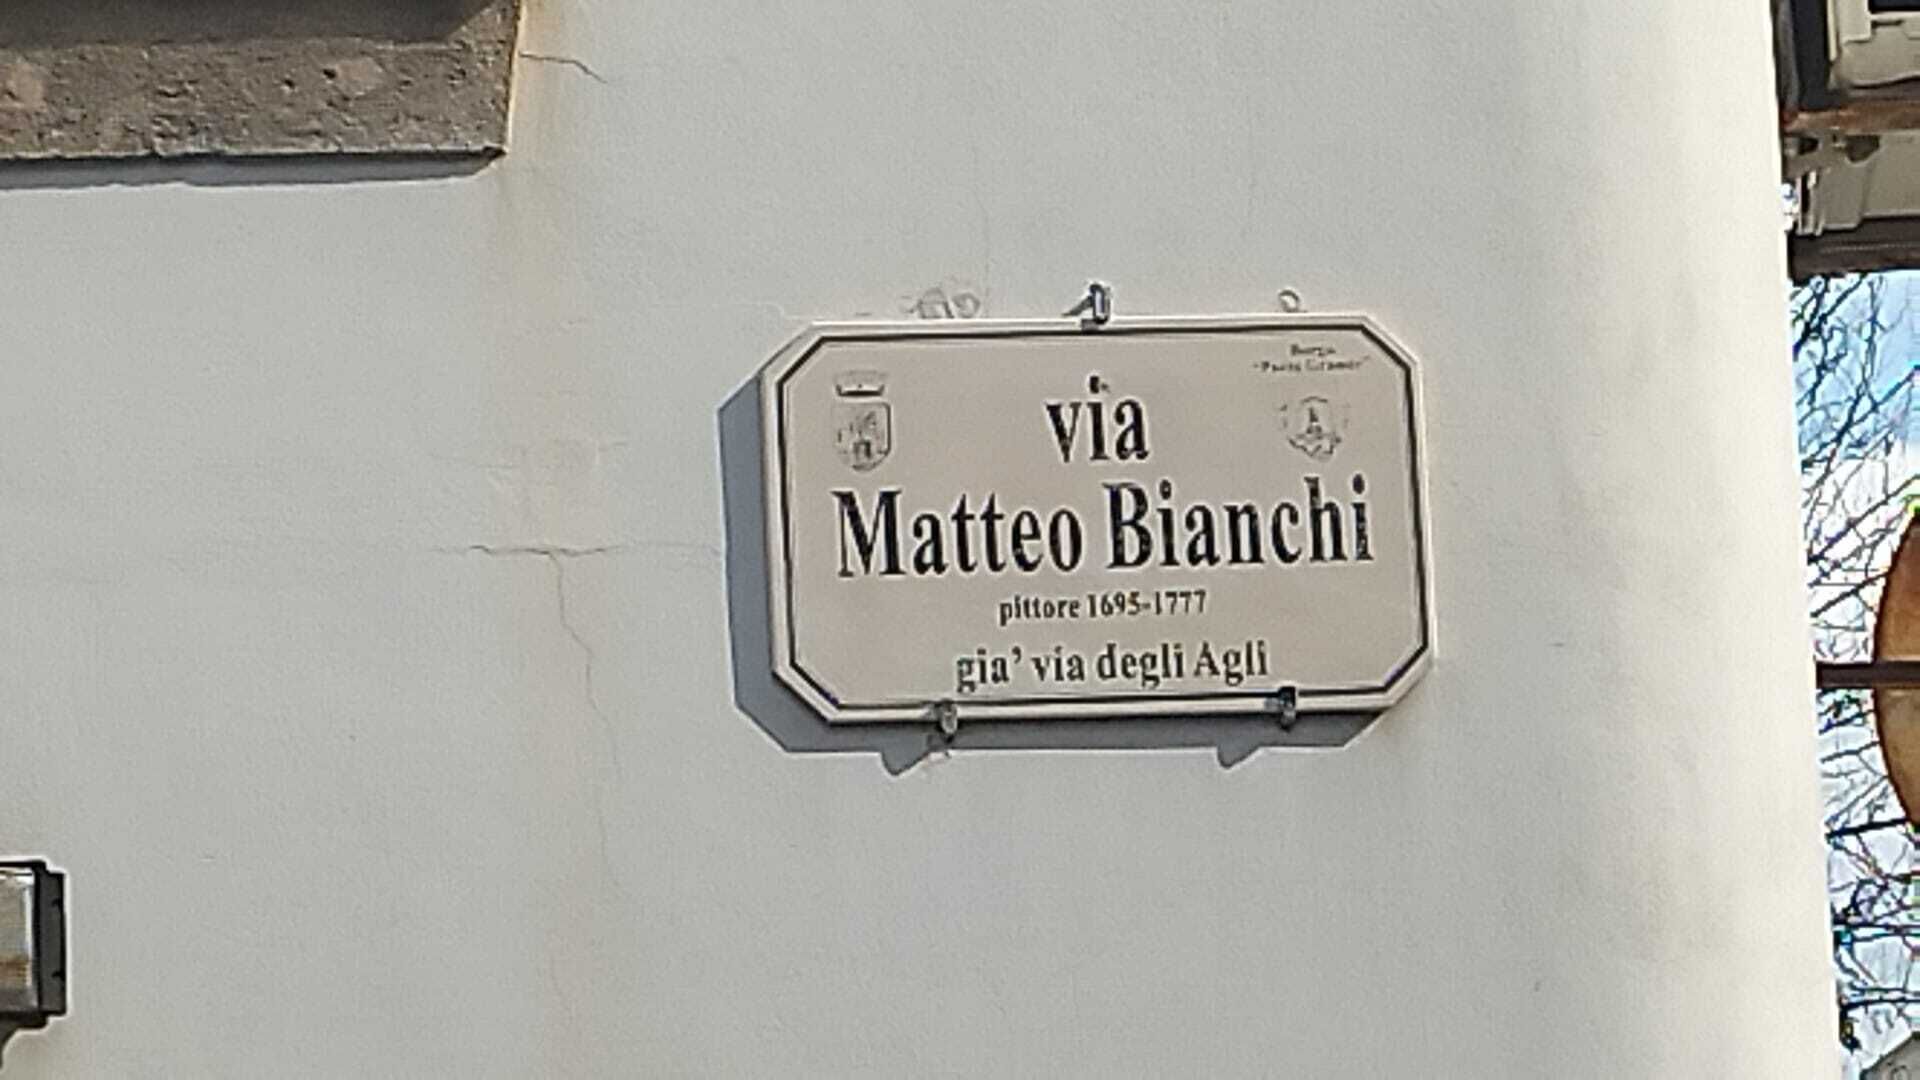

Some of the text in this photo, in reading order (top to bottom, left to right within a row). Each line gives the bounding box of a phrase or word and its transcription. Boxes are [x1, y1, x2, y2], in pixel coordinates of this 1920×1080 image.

[1046, 375, 1150, 463] via
[831, 474, 1375, 578] Matteo Bianchi
[999, 589, 1207, 627] pittore 1695-1777
[1031, 645, 1085, 683] via
[1096, 643, 1184, 690] degli
[1193, 639, 1268, 688] Agli
